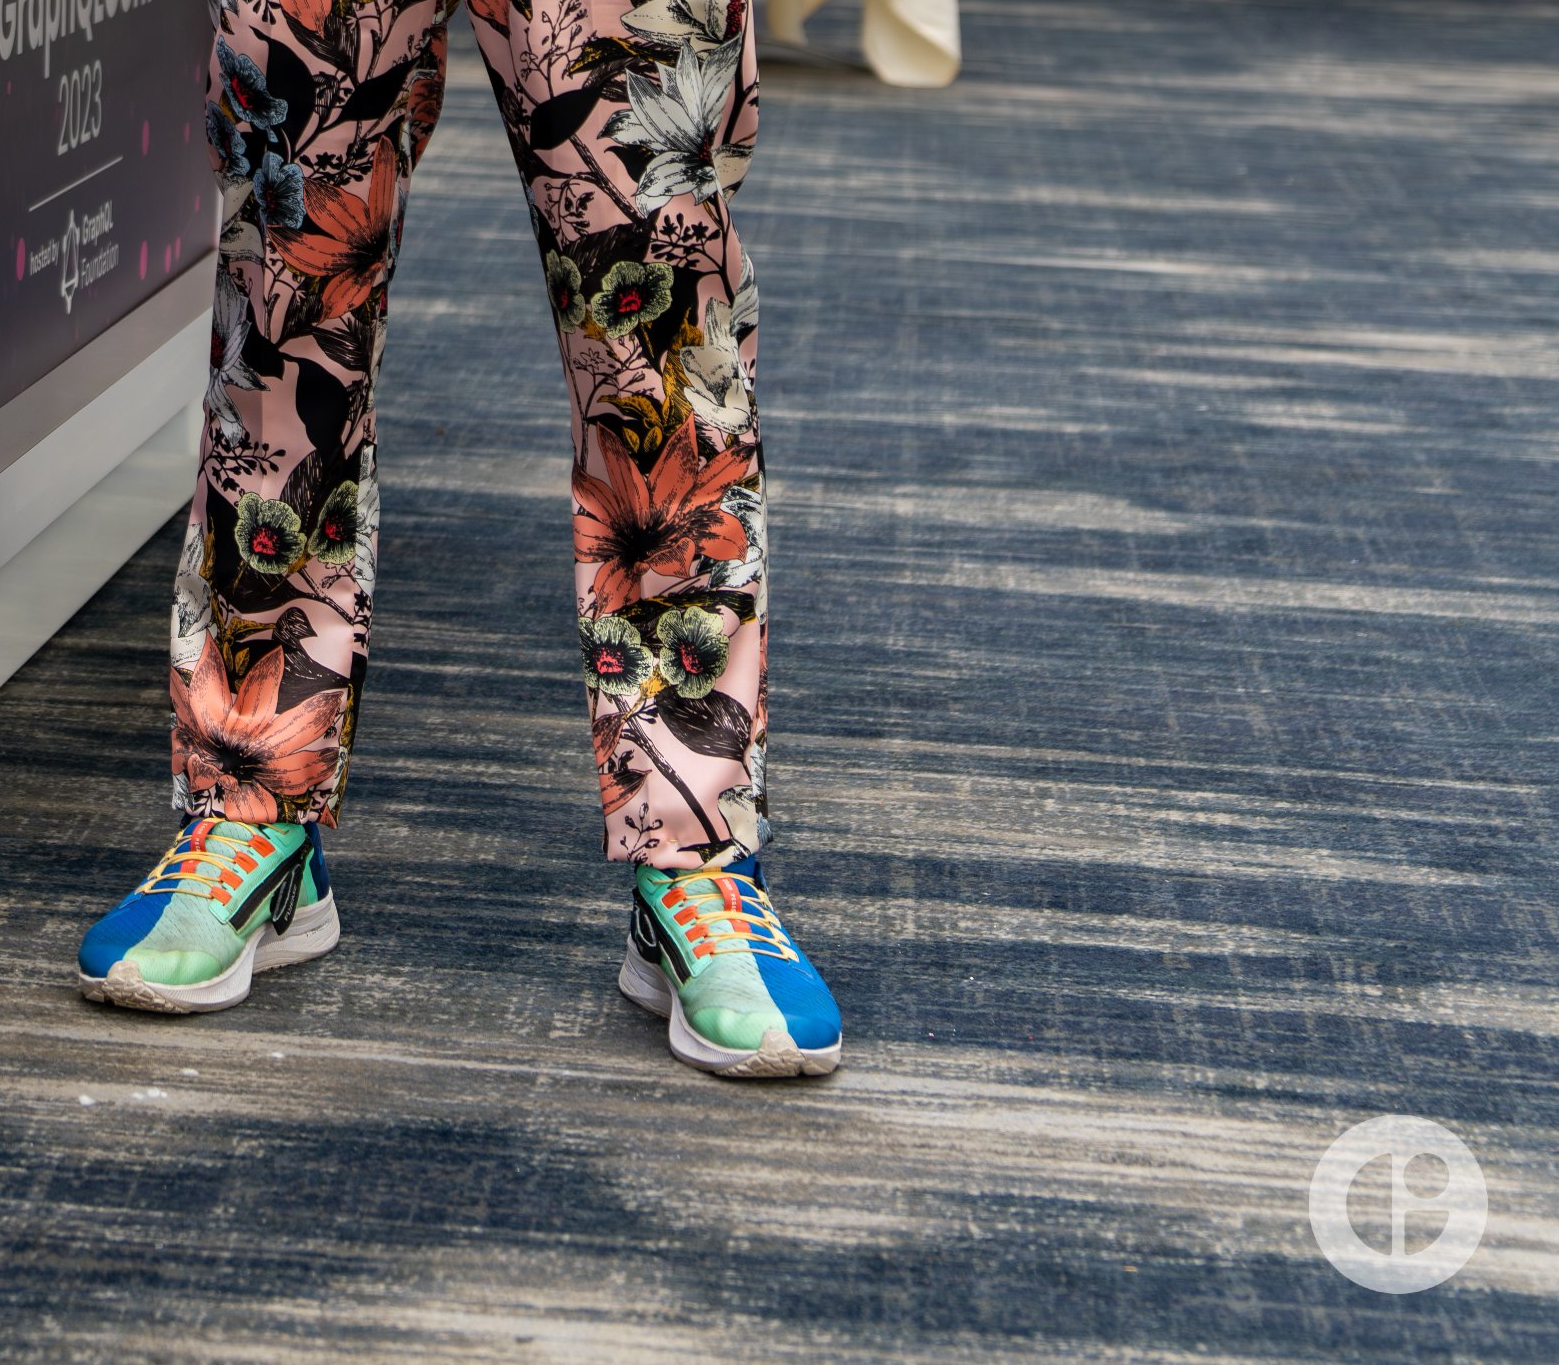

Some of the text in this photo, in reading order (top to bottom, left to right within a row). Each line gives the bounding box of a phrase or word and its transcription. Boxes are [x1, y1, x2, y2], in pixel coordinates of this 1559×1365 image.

[57, 59, 102, 156] 2023
[83, 199, 113, 247] GraphQL
[30, 238, 60, 277] hosted by
[81, 240, 119, 289] Foundation
